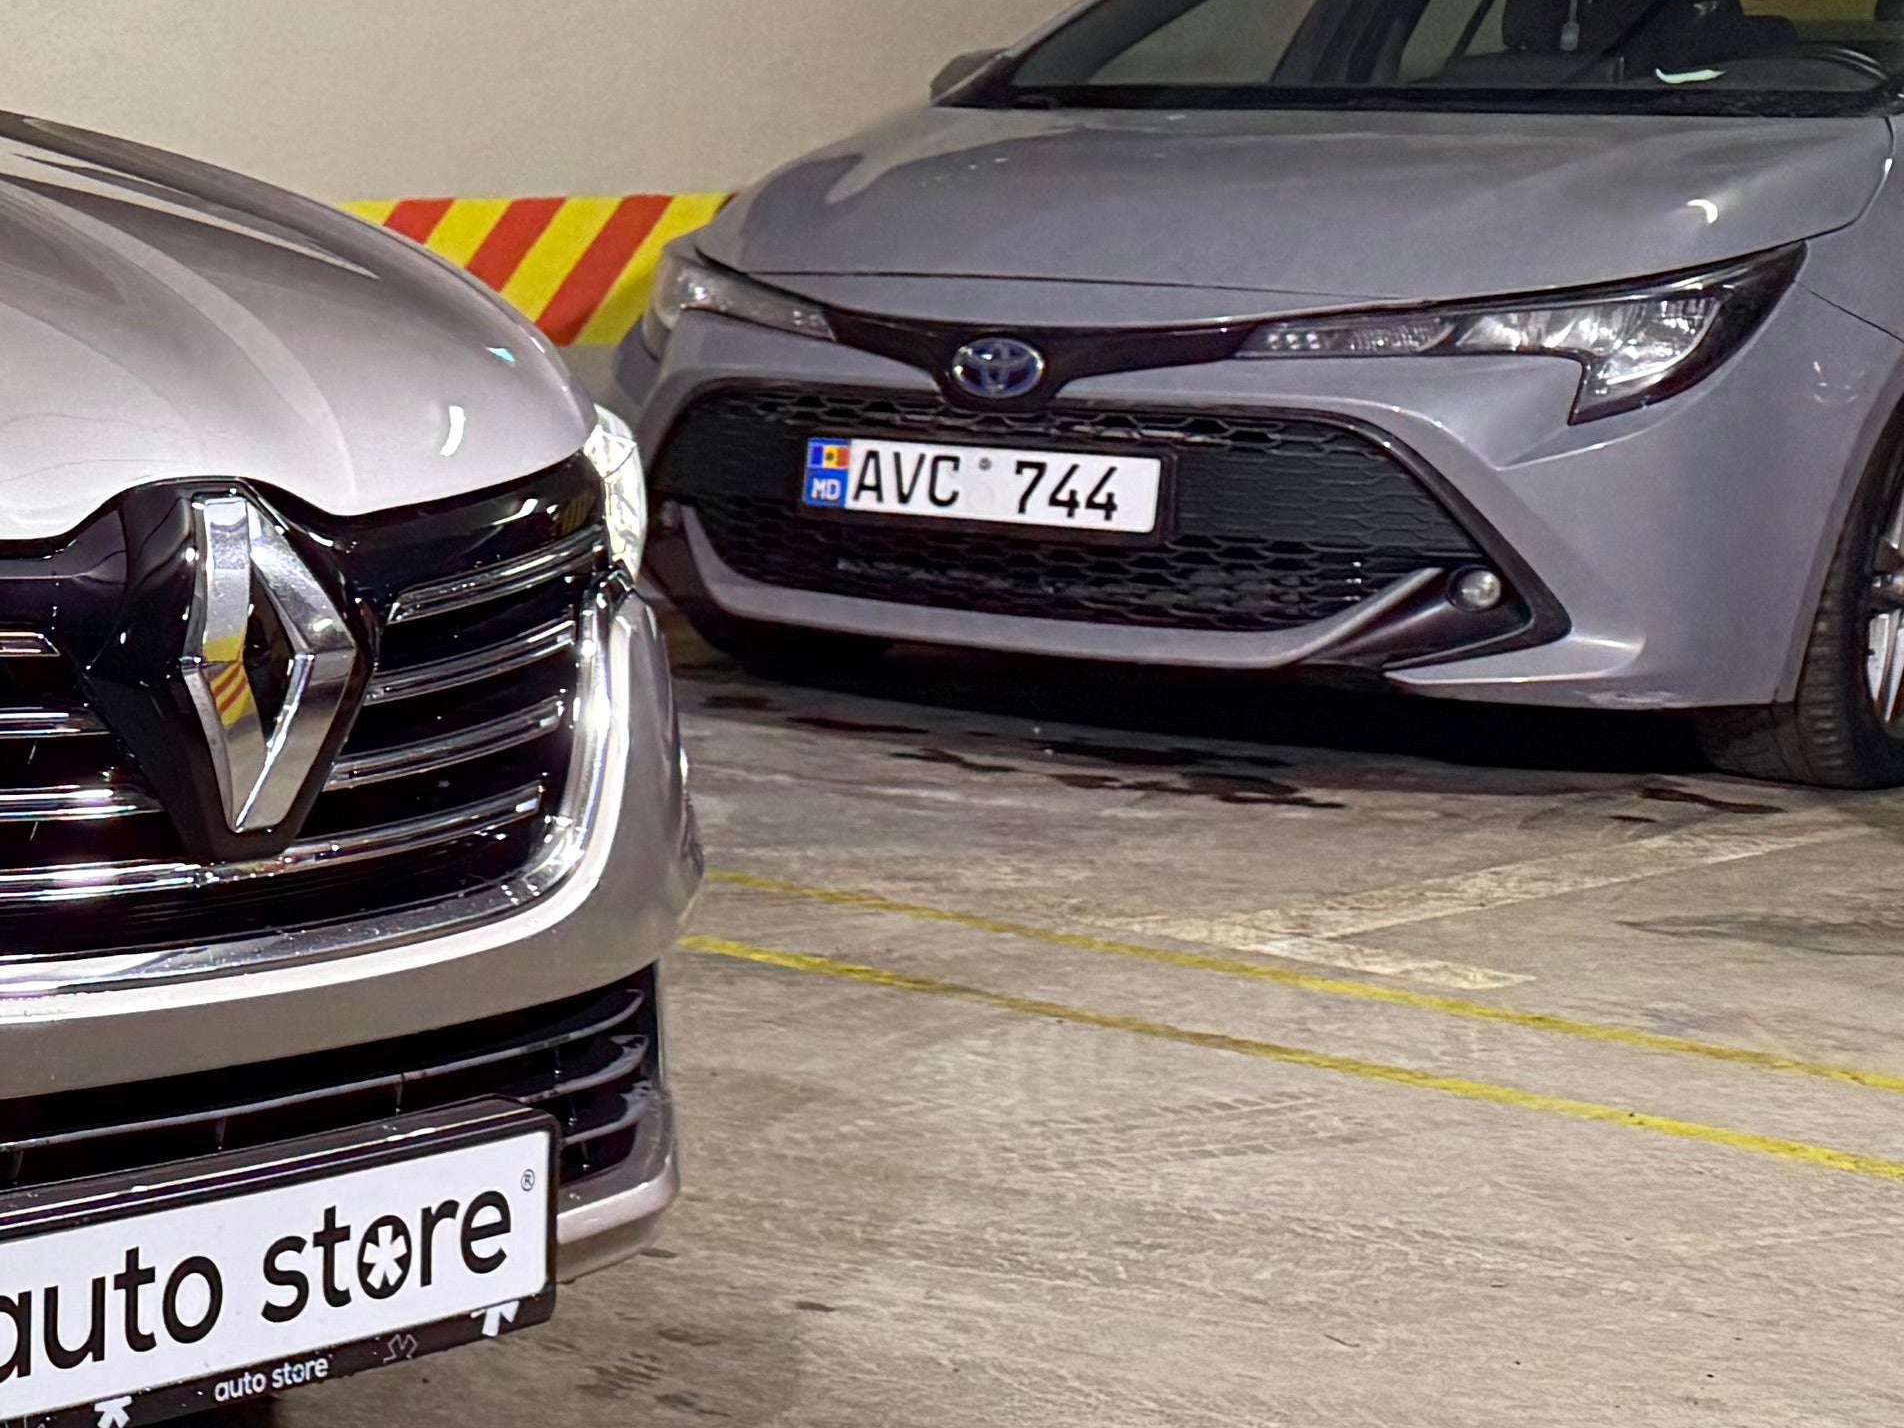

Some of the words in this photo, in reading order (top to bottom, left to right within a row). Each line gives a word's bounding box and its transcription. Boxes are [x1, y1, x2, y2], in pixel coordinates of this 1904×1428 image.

[811, 477, 842, 501] MD
[852, 449, 961, 507] AVC
[1014, 459, 1120, 522] 744
[260, 1188, 512, 1323] store
[214, 1371, 267, 1402] auto
[271, 1357, 329, 1389] store
